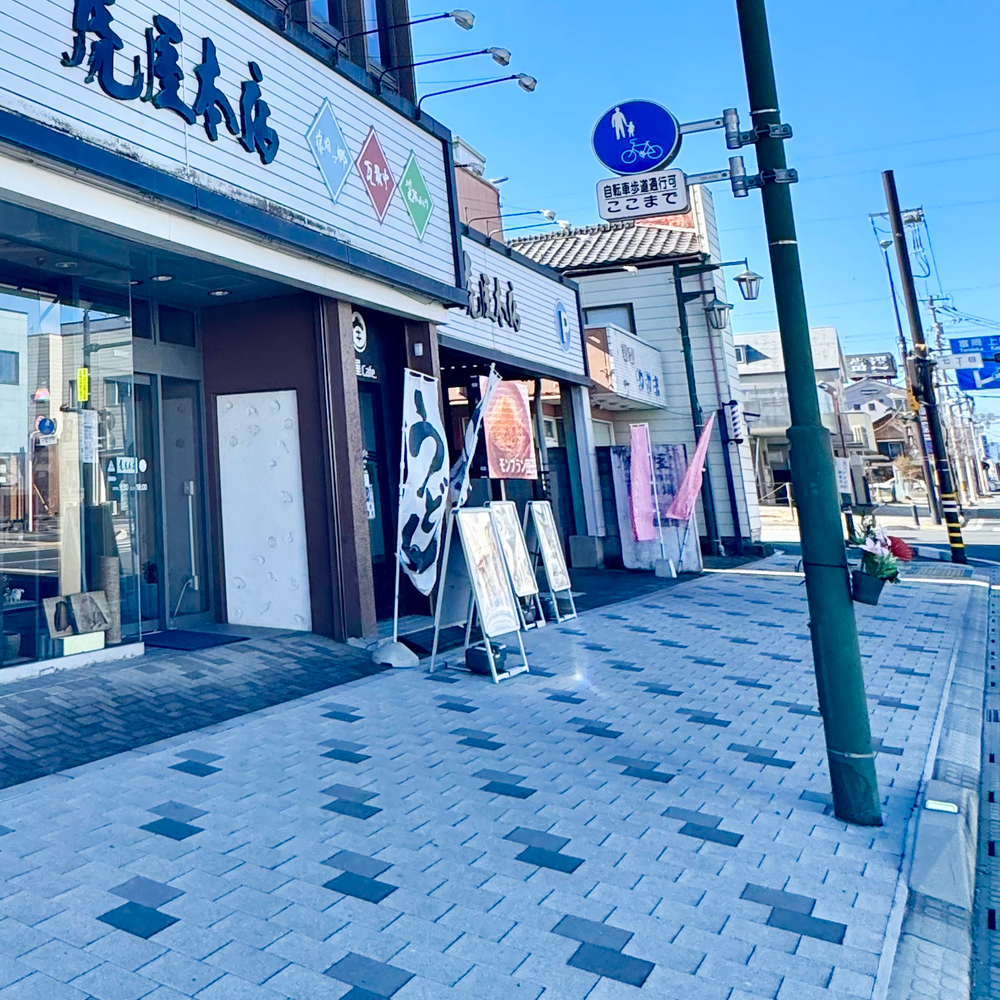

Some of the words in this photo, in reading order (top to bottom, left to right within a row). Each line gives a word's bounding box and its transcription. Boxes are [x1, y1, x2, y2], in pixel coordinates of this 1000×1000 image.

[603, 174, 677, 198] 自転車歩道通行可
[607, 192, 678, 213] ここまで
[560, 310, 571, 343] P
[499, 458, 526, 473] モンブラン
